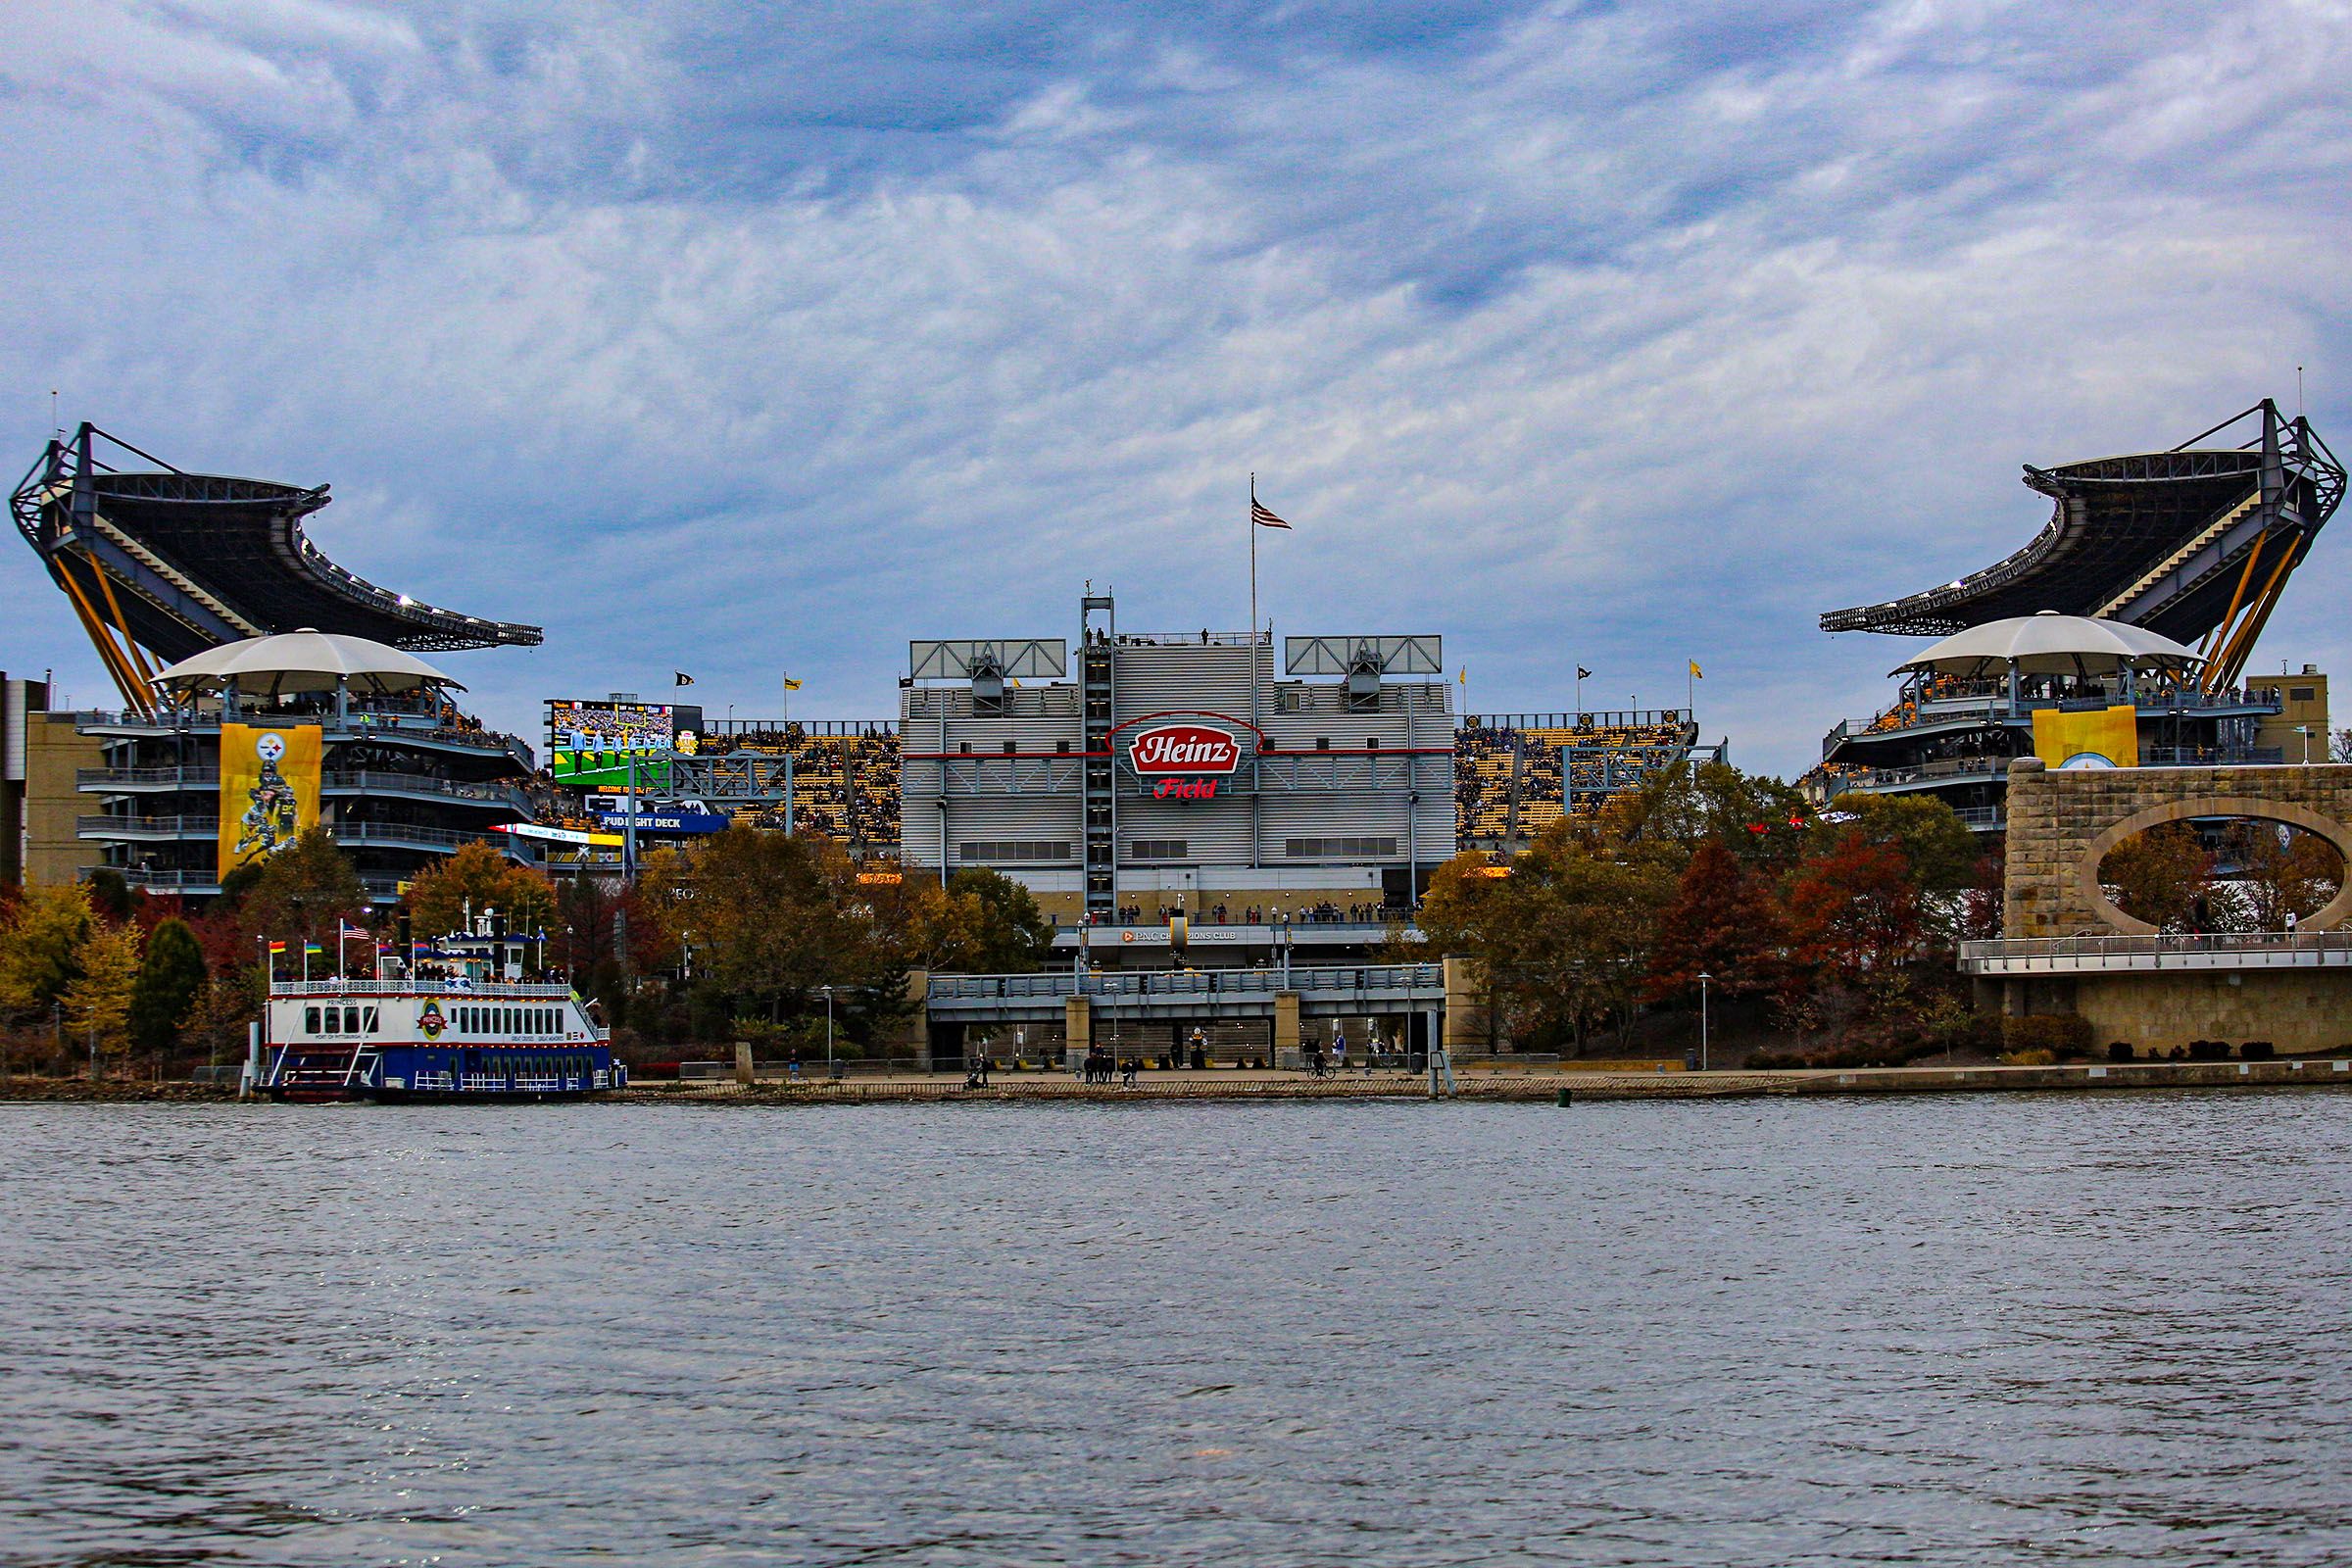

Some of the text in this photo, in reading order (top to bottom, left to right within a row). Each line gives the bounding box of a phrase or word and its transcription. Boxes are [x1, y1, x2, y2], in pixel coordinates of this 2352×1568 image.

[1139, 735, 1231, 763] Heinz
[1152, 777, 1219, 800] Field
[655, 818, 681, 828] DECK
[1136, 931, 1158, 941] PNC
[1213, 931, 1236, 941] CLUB
